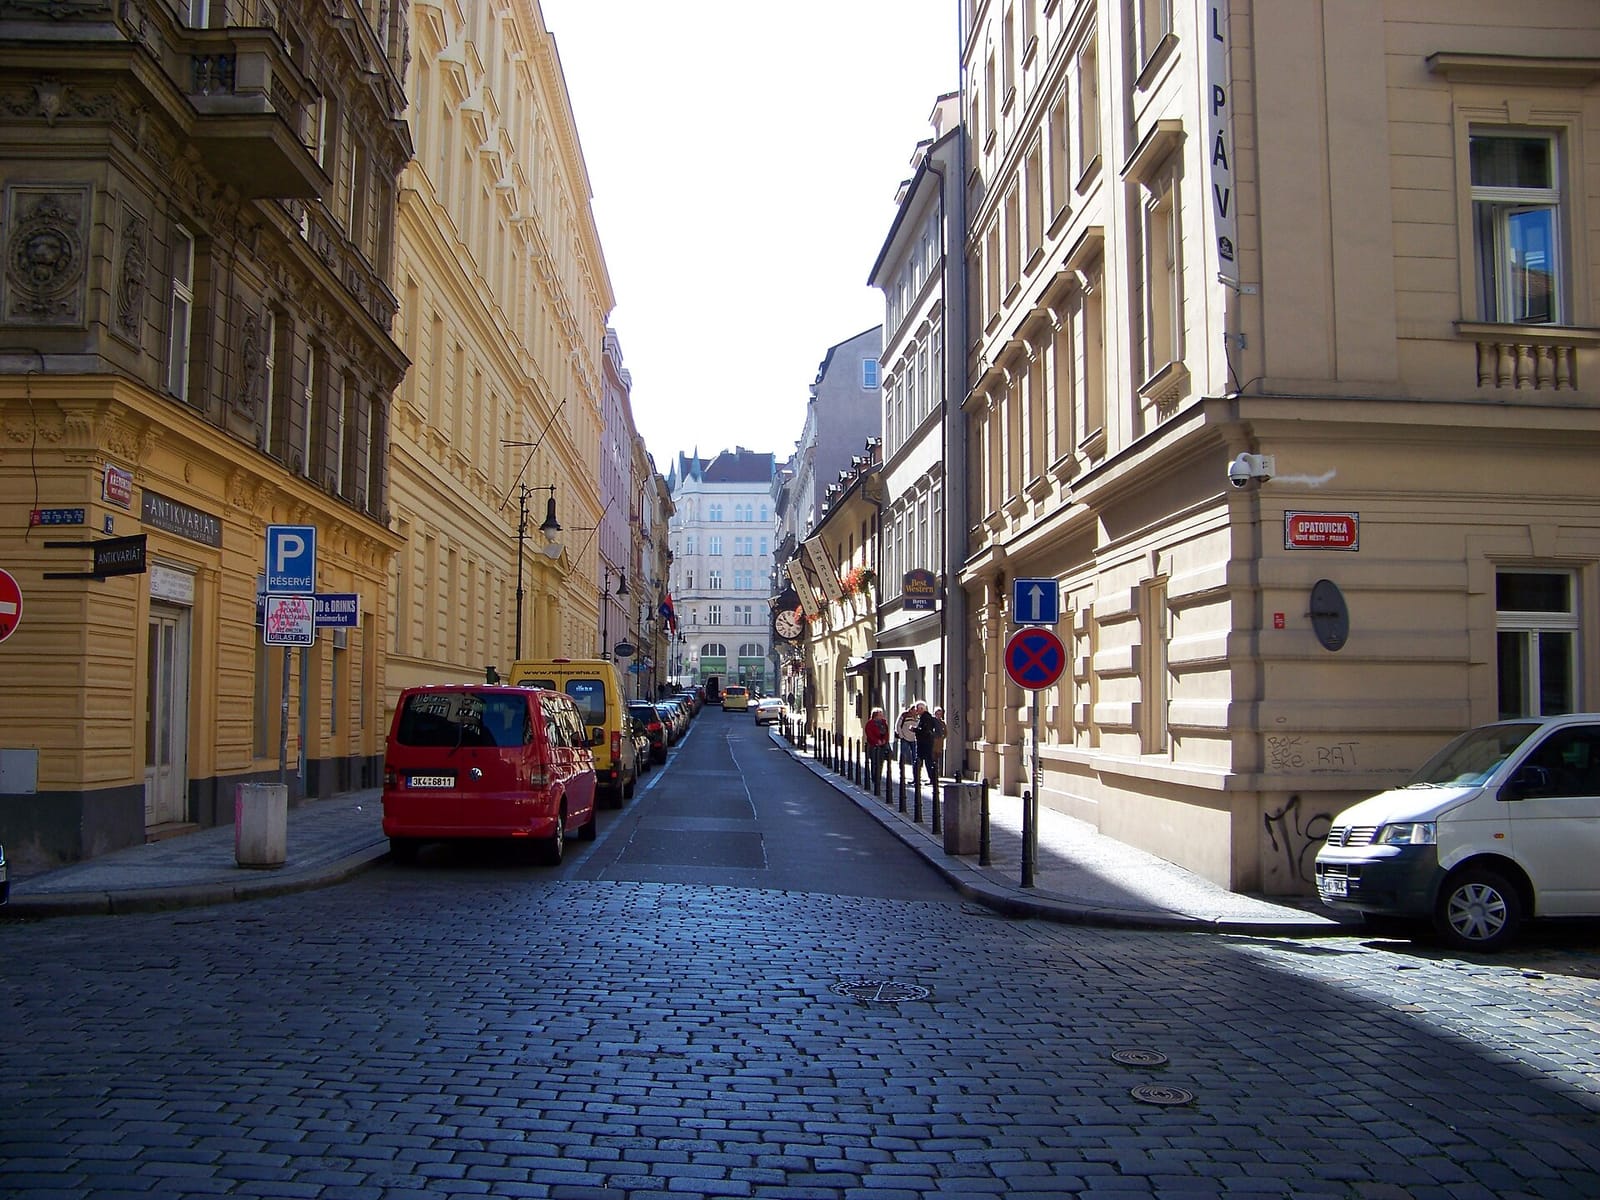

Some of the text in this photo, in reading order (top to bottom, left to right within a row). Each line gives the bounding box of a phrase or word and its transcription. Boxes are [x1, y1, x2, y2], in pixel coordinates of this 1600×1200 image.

[151, 498, 214, 536] ANTIKVARIÁT
[1298, 521, 1348, 533] OPATOVICKÁ
[98, 547, 140, 564] ANTIKVARIÁT
[277, 534, 305, 572] P
[269, 576, 311, 586] RÉSERVÉ
[905, 585, 934, 593] Western
[324, 601, 330, 612] &
[331, 600, 356, 613] DRINKS
[412, 777, 452, 786] 3K4 6811
